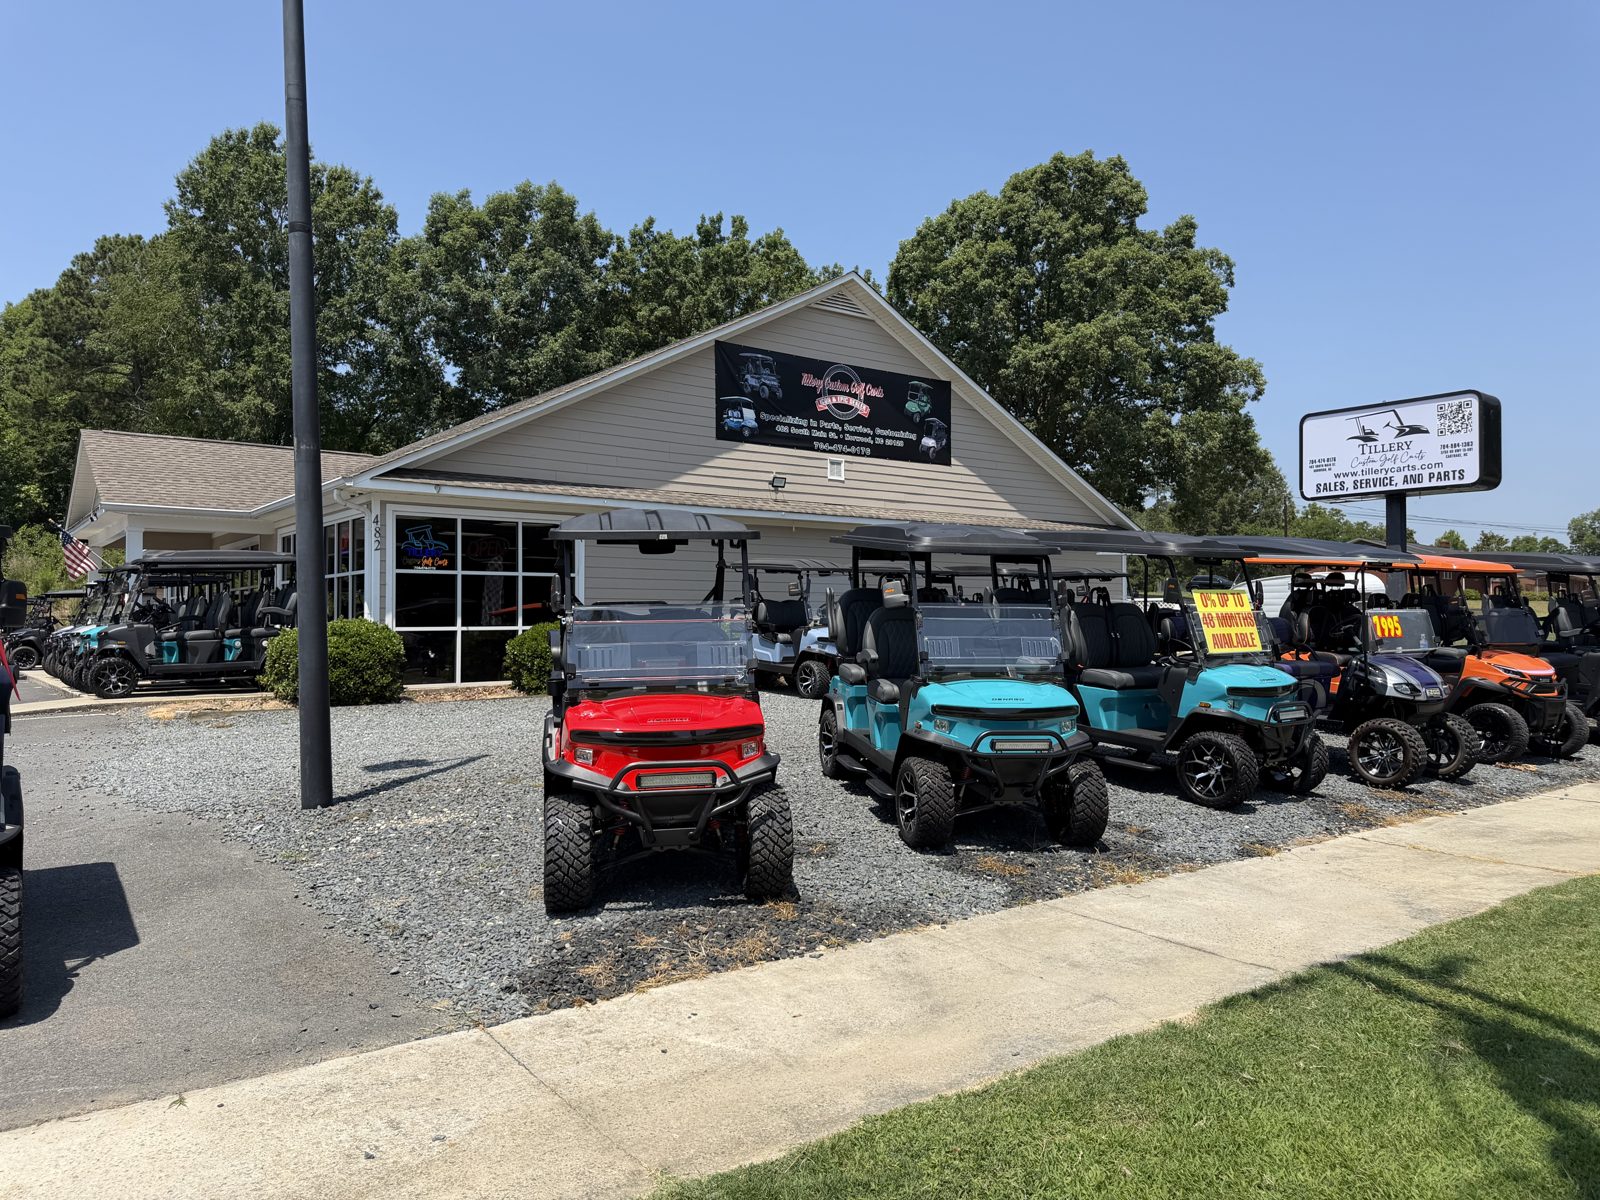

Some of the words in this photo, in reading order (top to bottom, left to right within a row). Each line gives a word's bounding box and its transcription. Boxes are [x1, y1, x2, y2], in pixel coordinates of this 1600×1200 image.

[760, 412, 808, 427] Specializing
[810, 419, 817, 427] in
[820, 420, 842, 431] Parts,
[844, 423, 873, 435] Service,
[875, 427, 917, 440] Customizing
[790, 427, 810, 435] South
[811, 429, 827, 438] Main
[844, 434, 874, 445] Norwood,
[1358, 440, 1413, 455] TILLERY
[1350, 455, 1378, 468] Custom
[1379, 453, 1399, 467] Golf
[1400, 449, 1427, 463] Carts
[1333, 461, 1444, 479] www.tillerycarts.com
[1315, 480, 1349, 494] SALES,
[1353, 476, 1398, 490] SERVICE,
[1402, 473, 1424, 485] AND
[1428, 469, 1465, 483] PARTS
[1200, 593, 1216, 608] 0%
[1217, 593, 1229, 608] UP
[1230, 592, 1244, 608] TO
[1202, 612, 1216, 628] 48
[1216, 612, 1255, 628] MONTHS
[1211, 632, 1257, 649] AVAILABLE
